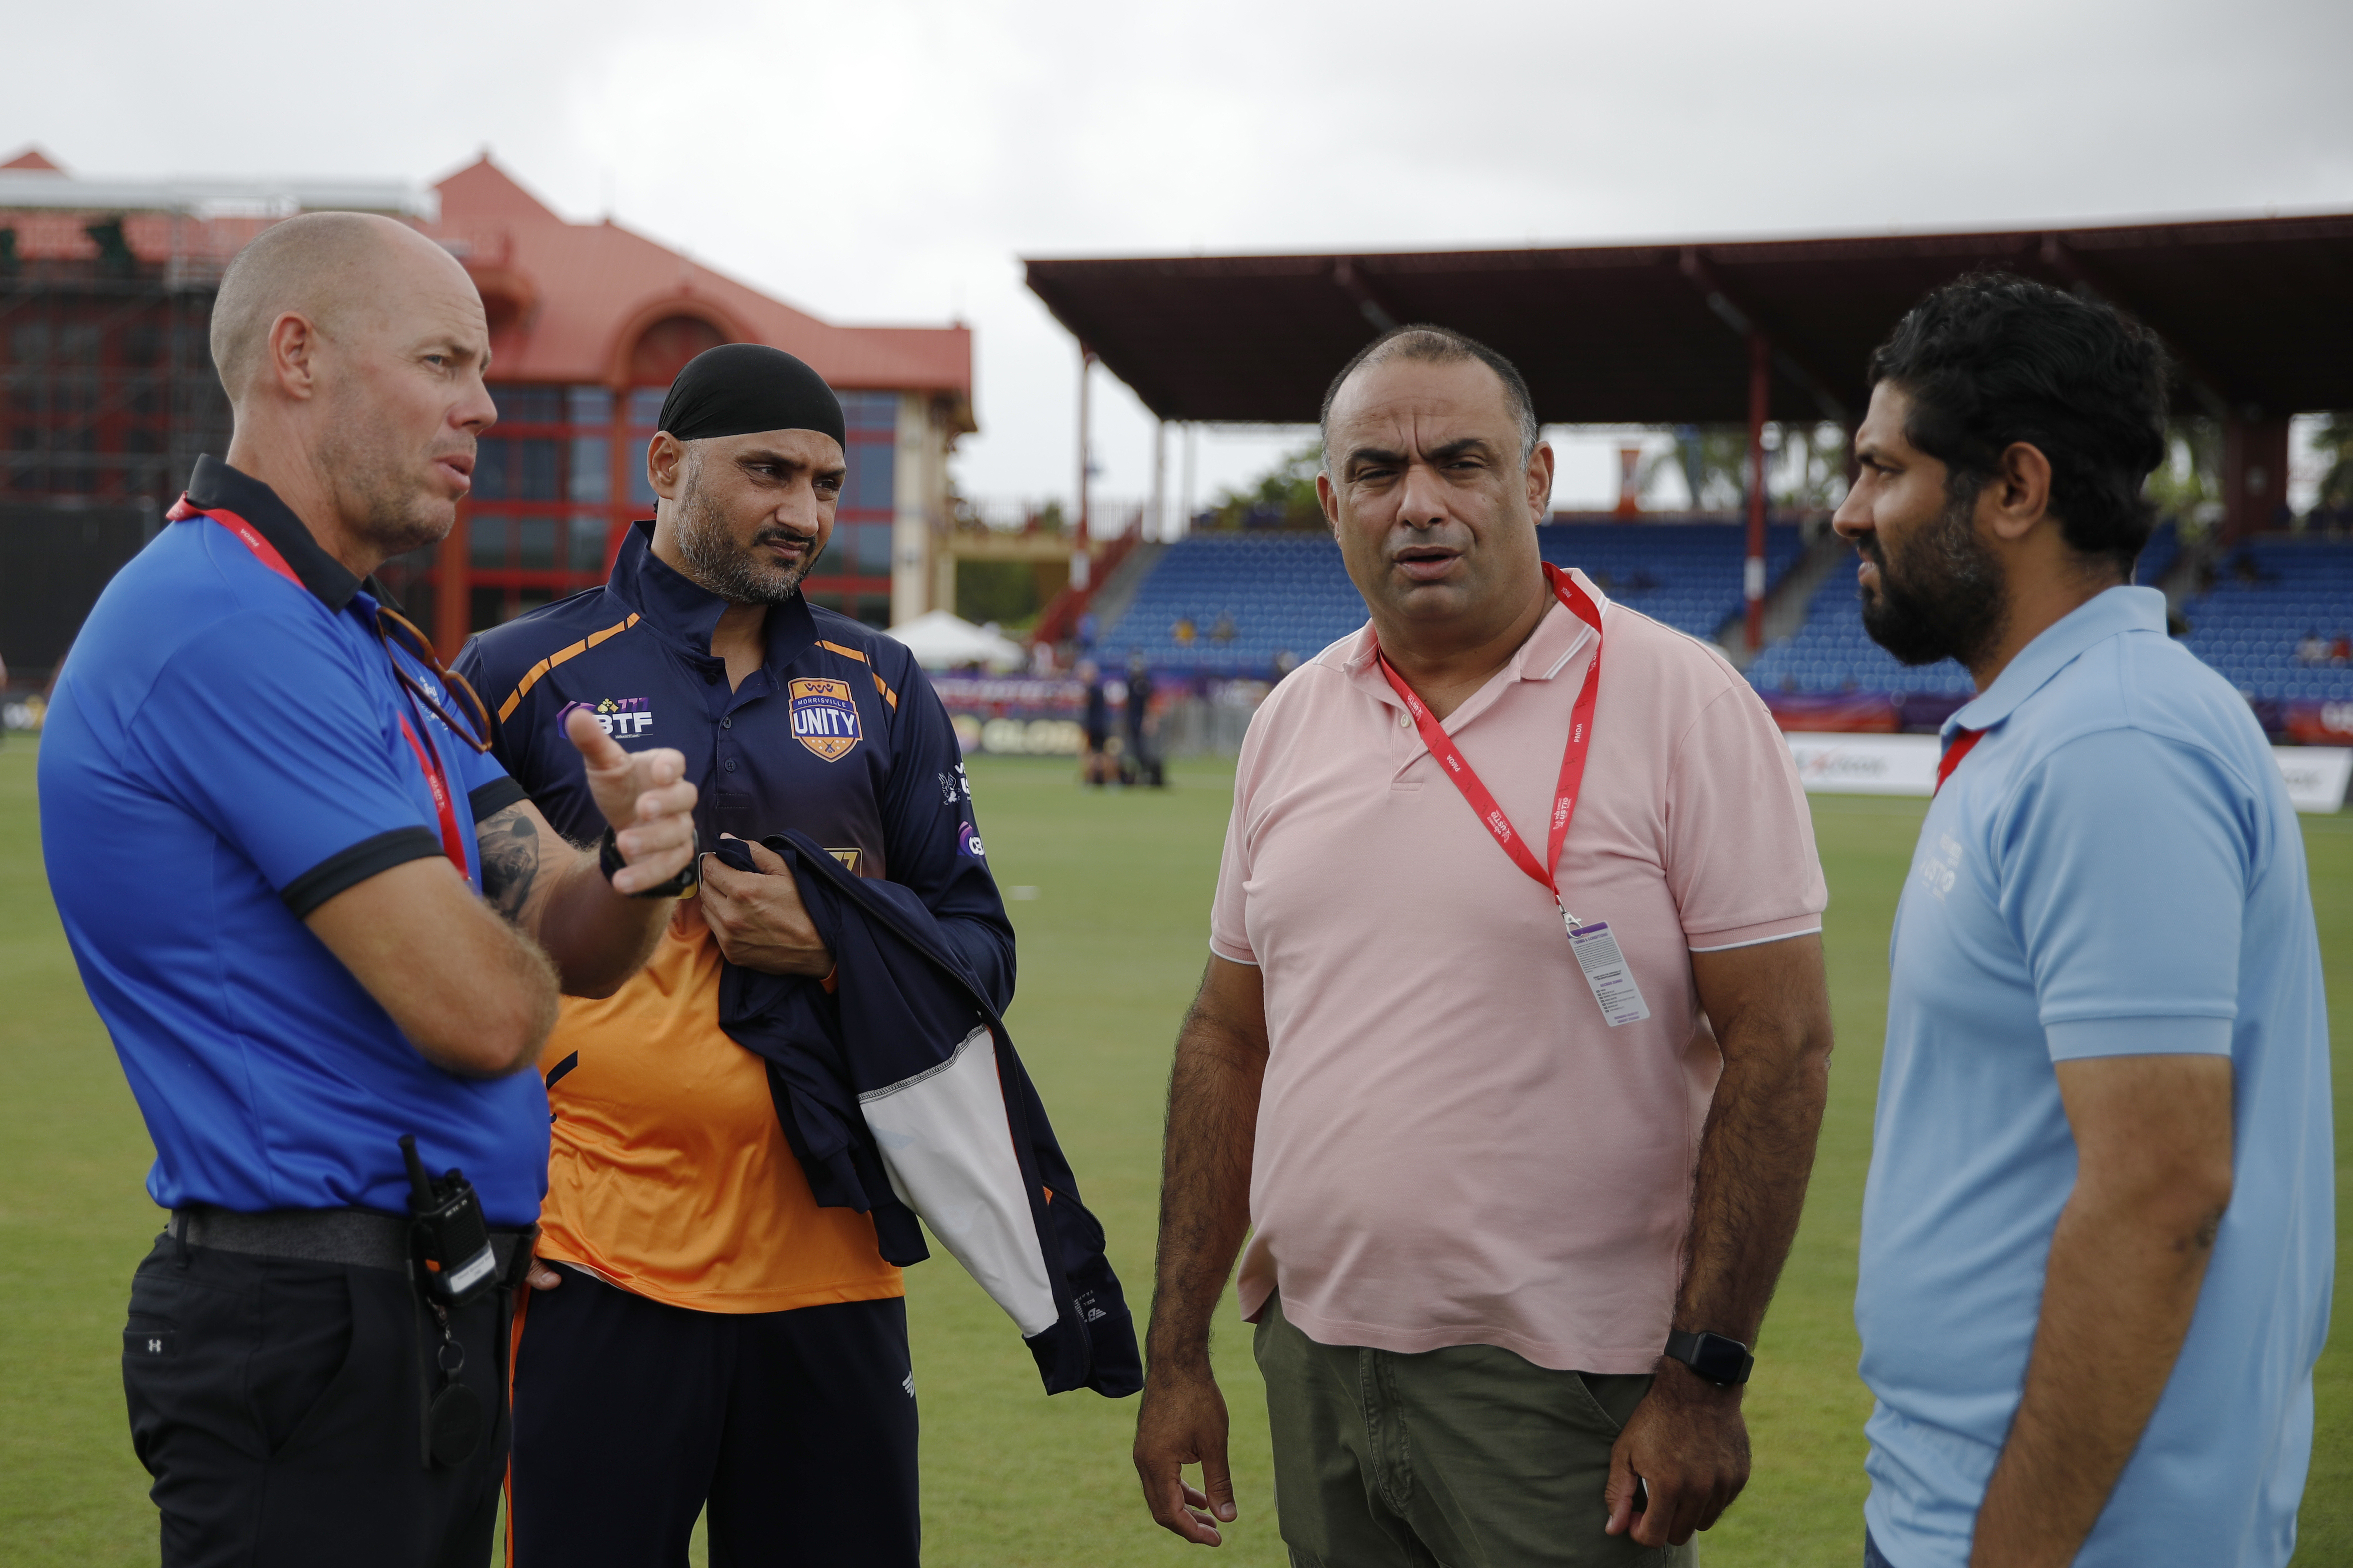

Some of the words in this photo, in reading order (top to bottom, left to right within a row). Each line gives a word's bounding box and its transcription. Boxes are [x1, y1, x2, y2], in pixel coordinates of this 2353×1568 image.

[241, 529, 260, 547] PMOA
[617, 697, 649, 713] 777
[798, 698, 847, 708] MORRISVILLE
[592, 711, 653, 734] BTF
[793, 707, 855, 735] UNITY
[1574, 723, 1583, 742] PMOA
[1446, 754, 1461, 772] PMOA
